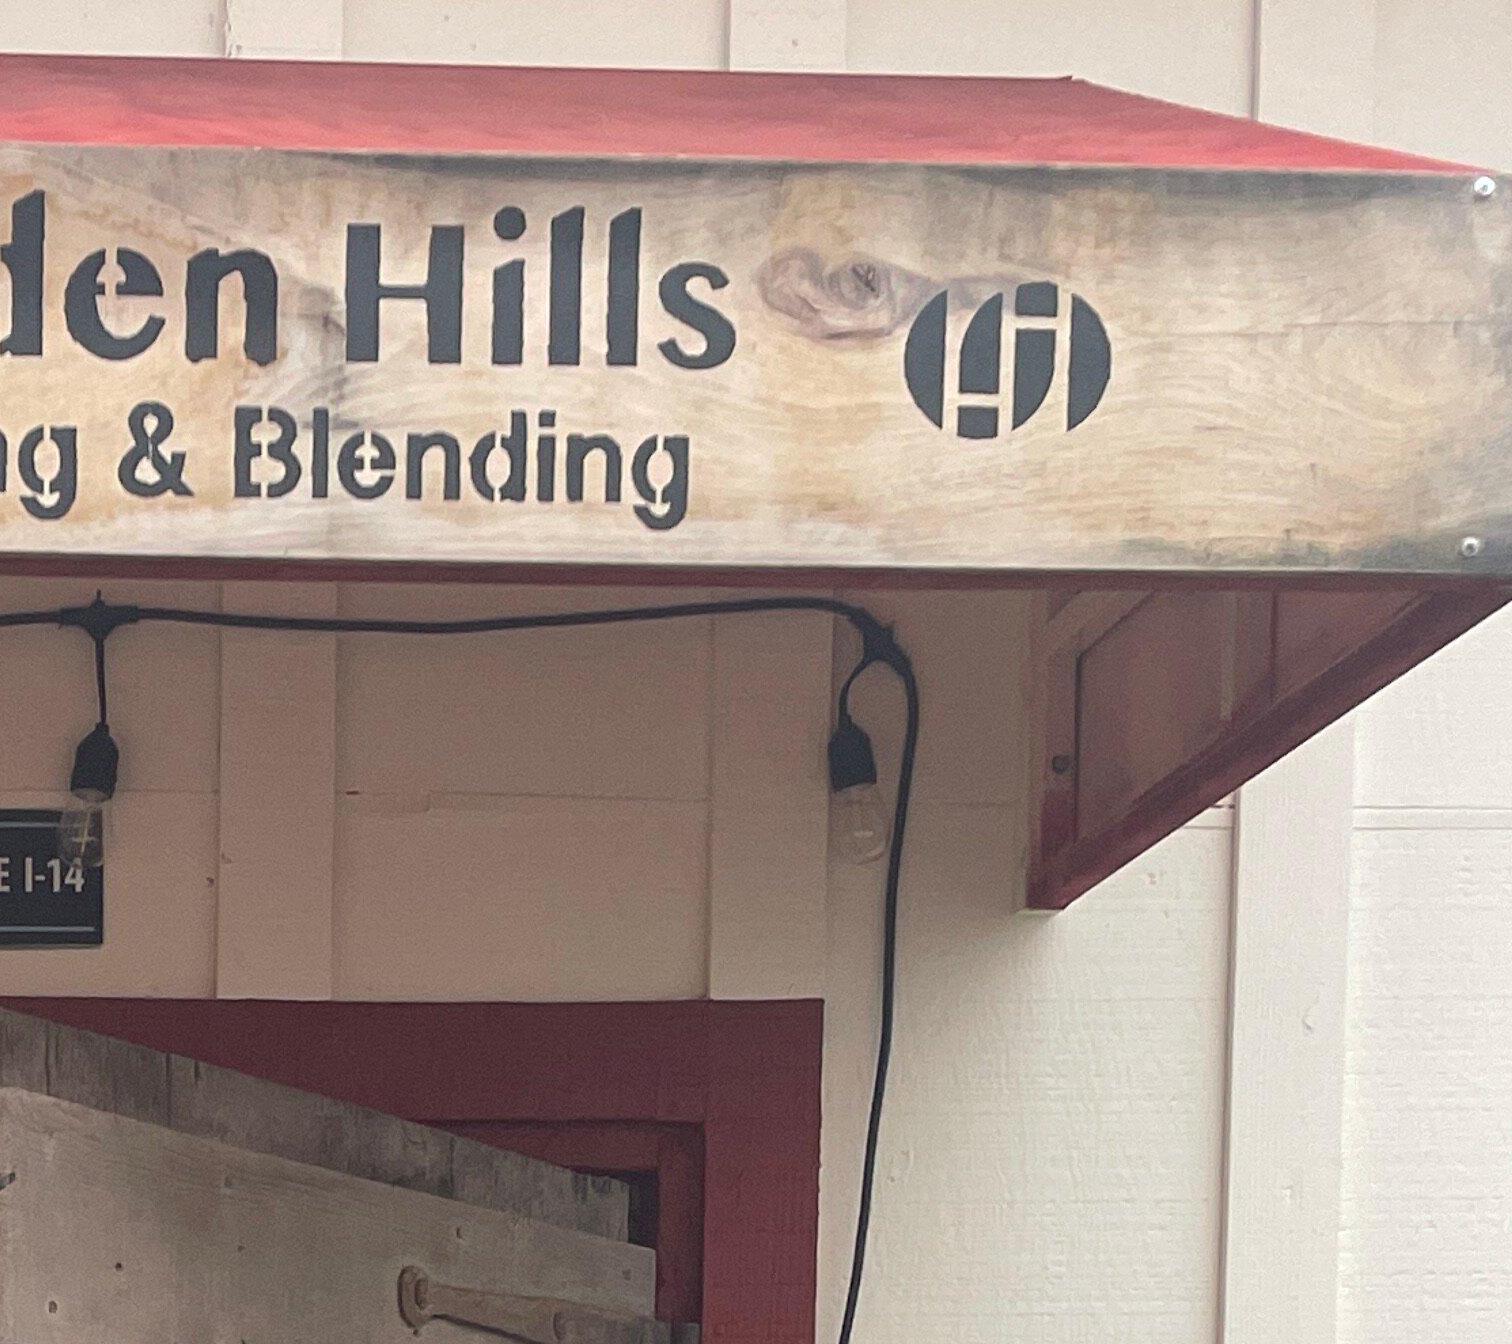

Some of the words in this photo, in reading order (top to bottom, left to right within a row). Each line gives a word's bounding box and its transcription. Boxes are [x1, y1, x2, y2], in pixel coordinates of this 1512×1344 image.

[345, 206, 735, 369] Hills
[118, 403, 193, 497] &
[234, 407, 689, 530] Blending
[26, 858, 84, 892] I-14
